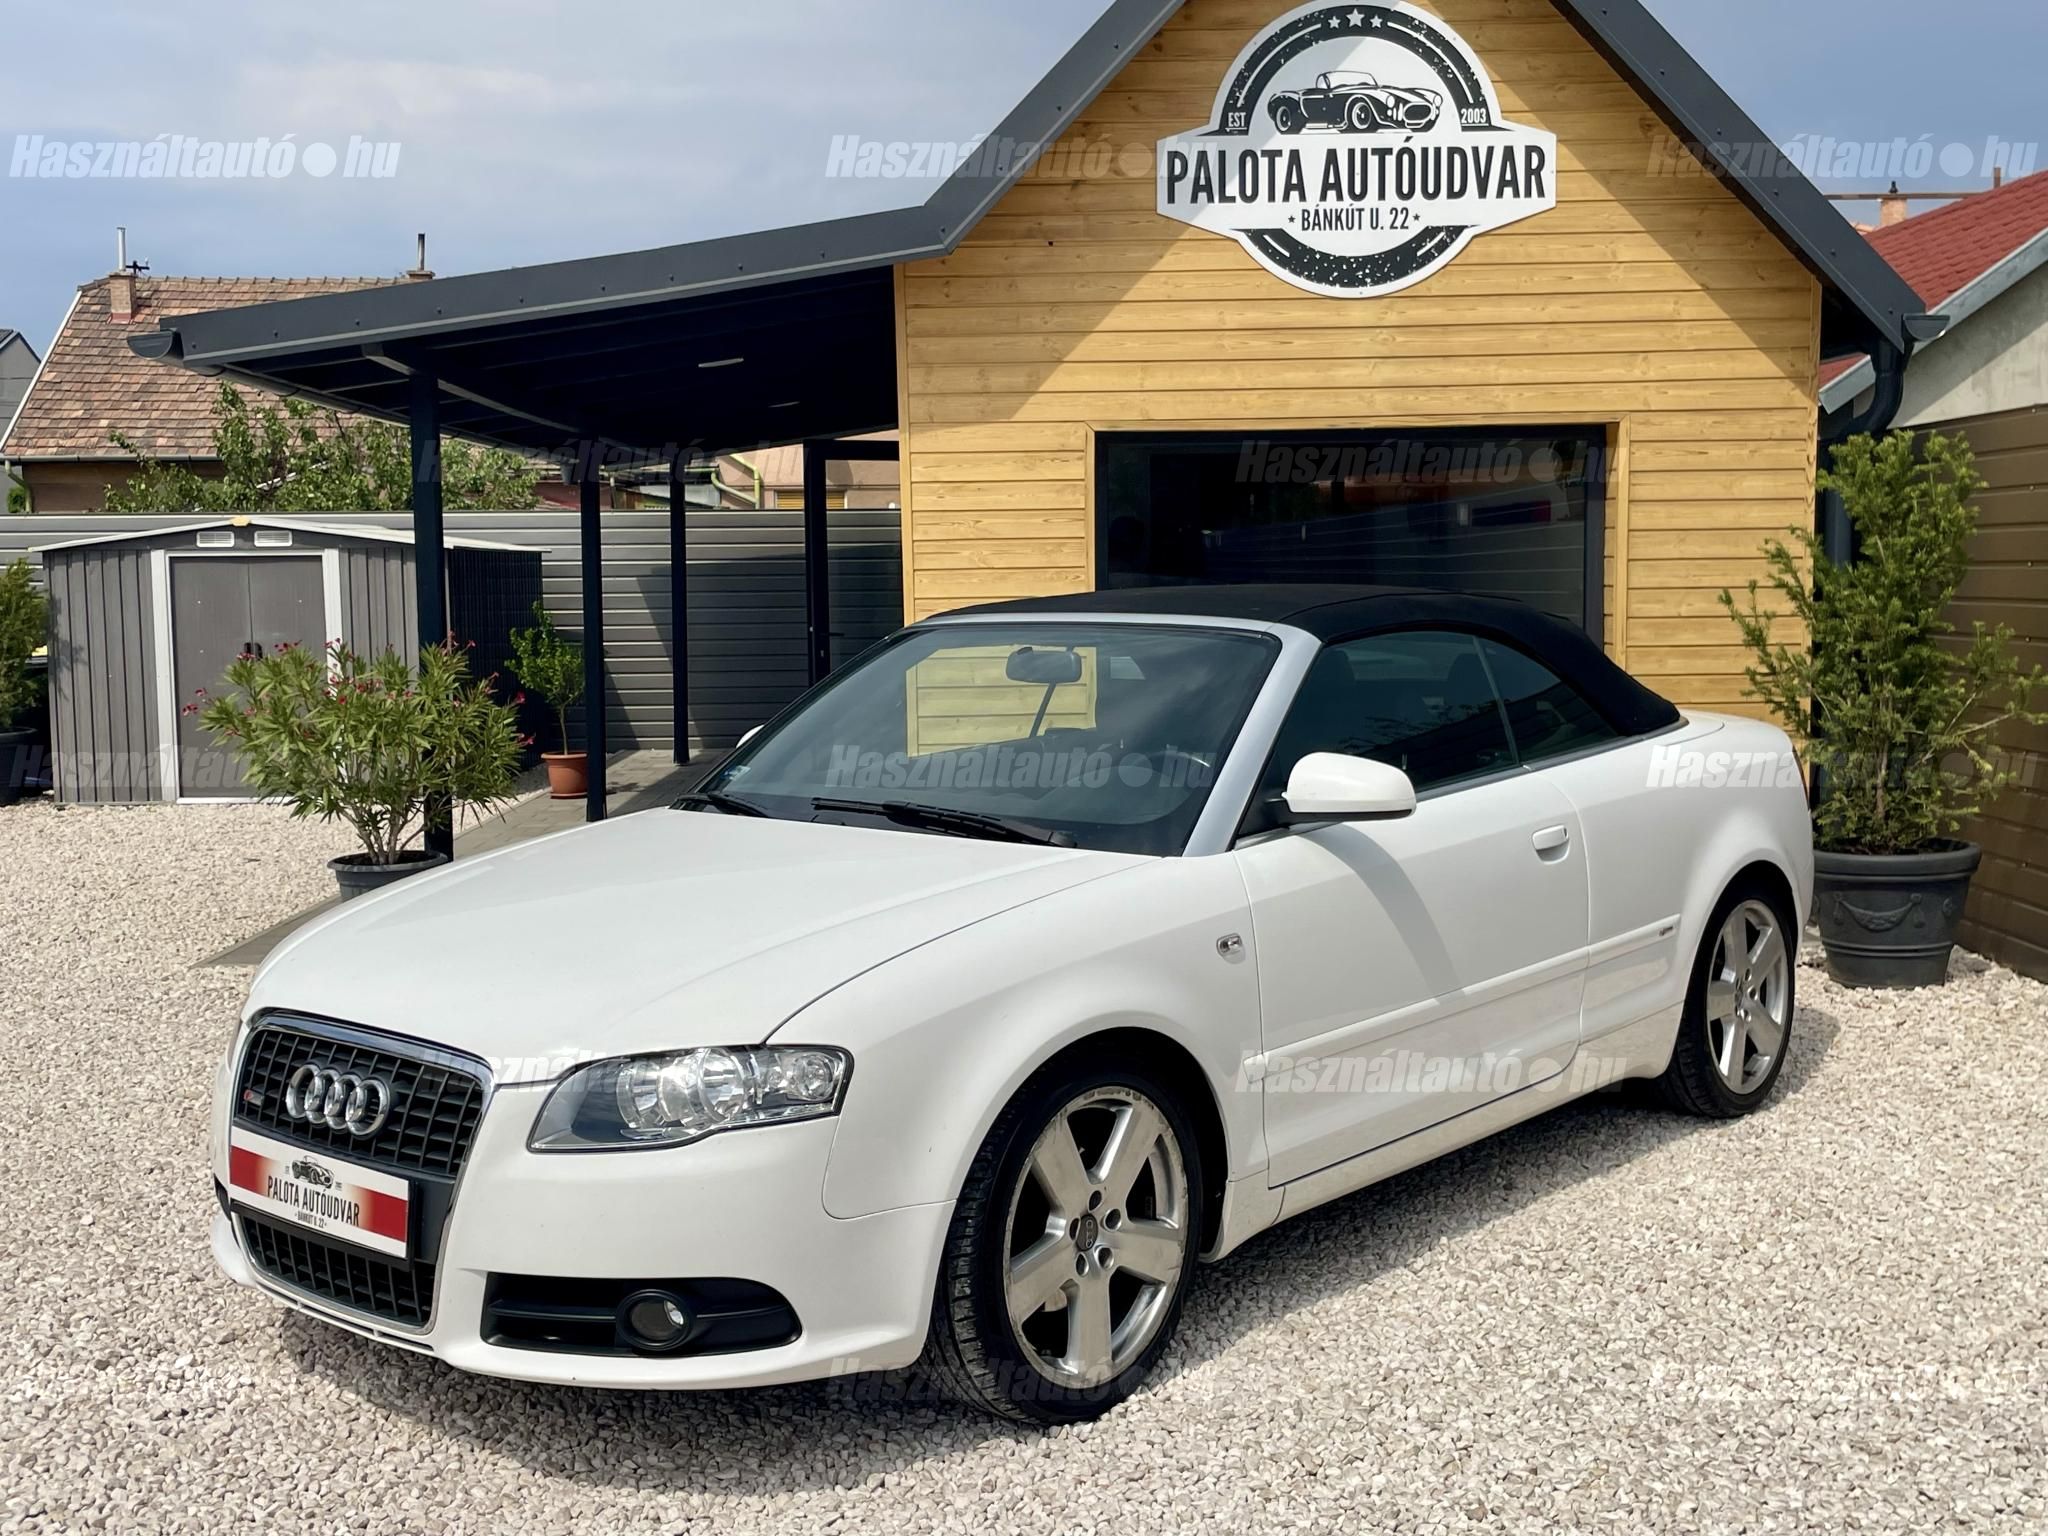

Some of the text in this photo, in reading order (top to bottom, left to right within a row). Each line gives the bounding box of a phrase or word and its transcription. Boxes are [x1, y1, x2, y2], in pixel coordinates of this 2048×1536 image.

[1228, 112, 1247, 127] EST
[1461, 108, 1487, 124] 2003
[1166, 136, 1547, 204] PALOTA AUTÓUDVAR
[1301, 203, 1410, 232] BÁNKÚT U. 22
[267, 1175, 360, 1228] PALOTA AUTÓUDVAR
